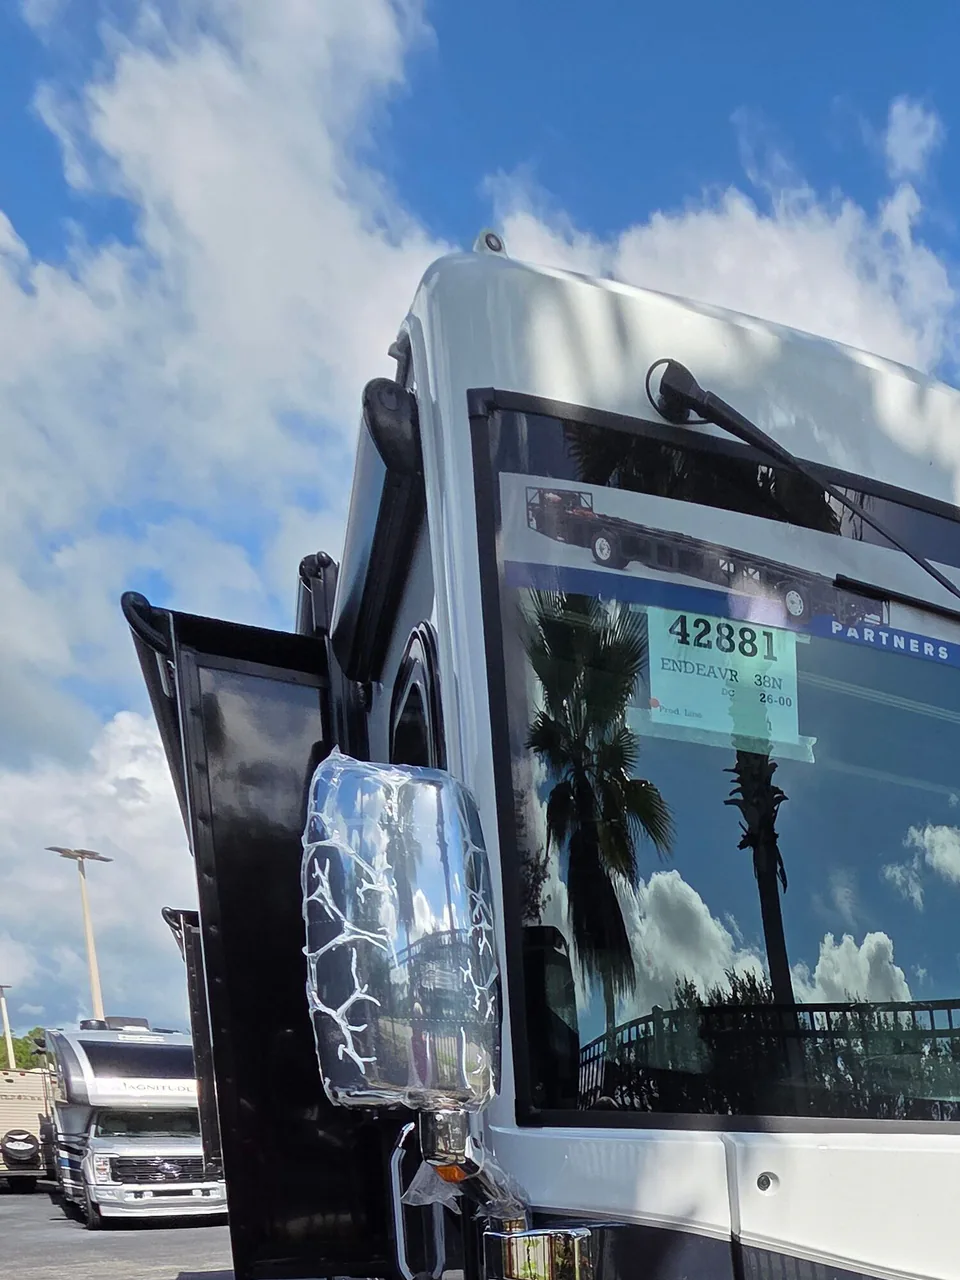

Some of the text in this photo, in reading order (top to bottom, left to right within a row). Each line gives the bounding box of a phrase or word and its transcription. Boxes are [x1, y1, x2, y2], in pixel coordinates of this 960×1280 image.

[669, 615, 777, 661] 42881
[831, 620, 949, 660] PARTNERS
[660, 657, 783, 690] ENDEAVR 38N
[759, 692, 792, 707] 26-00
